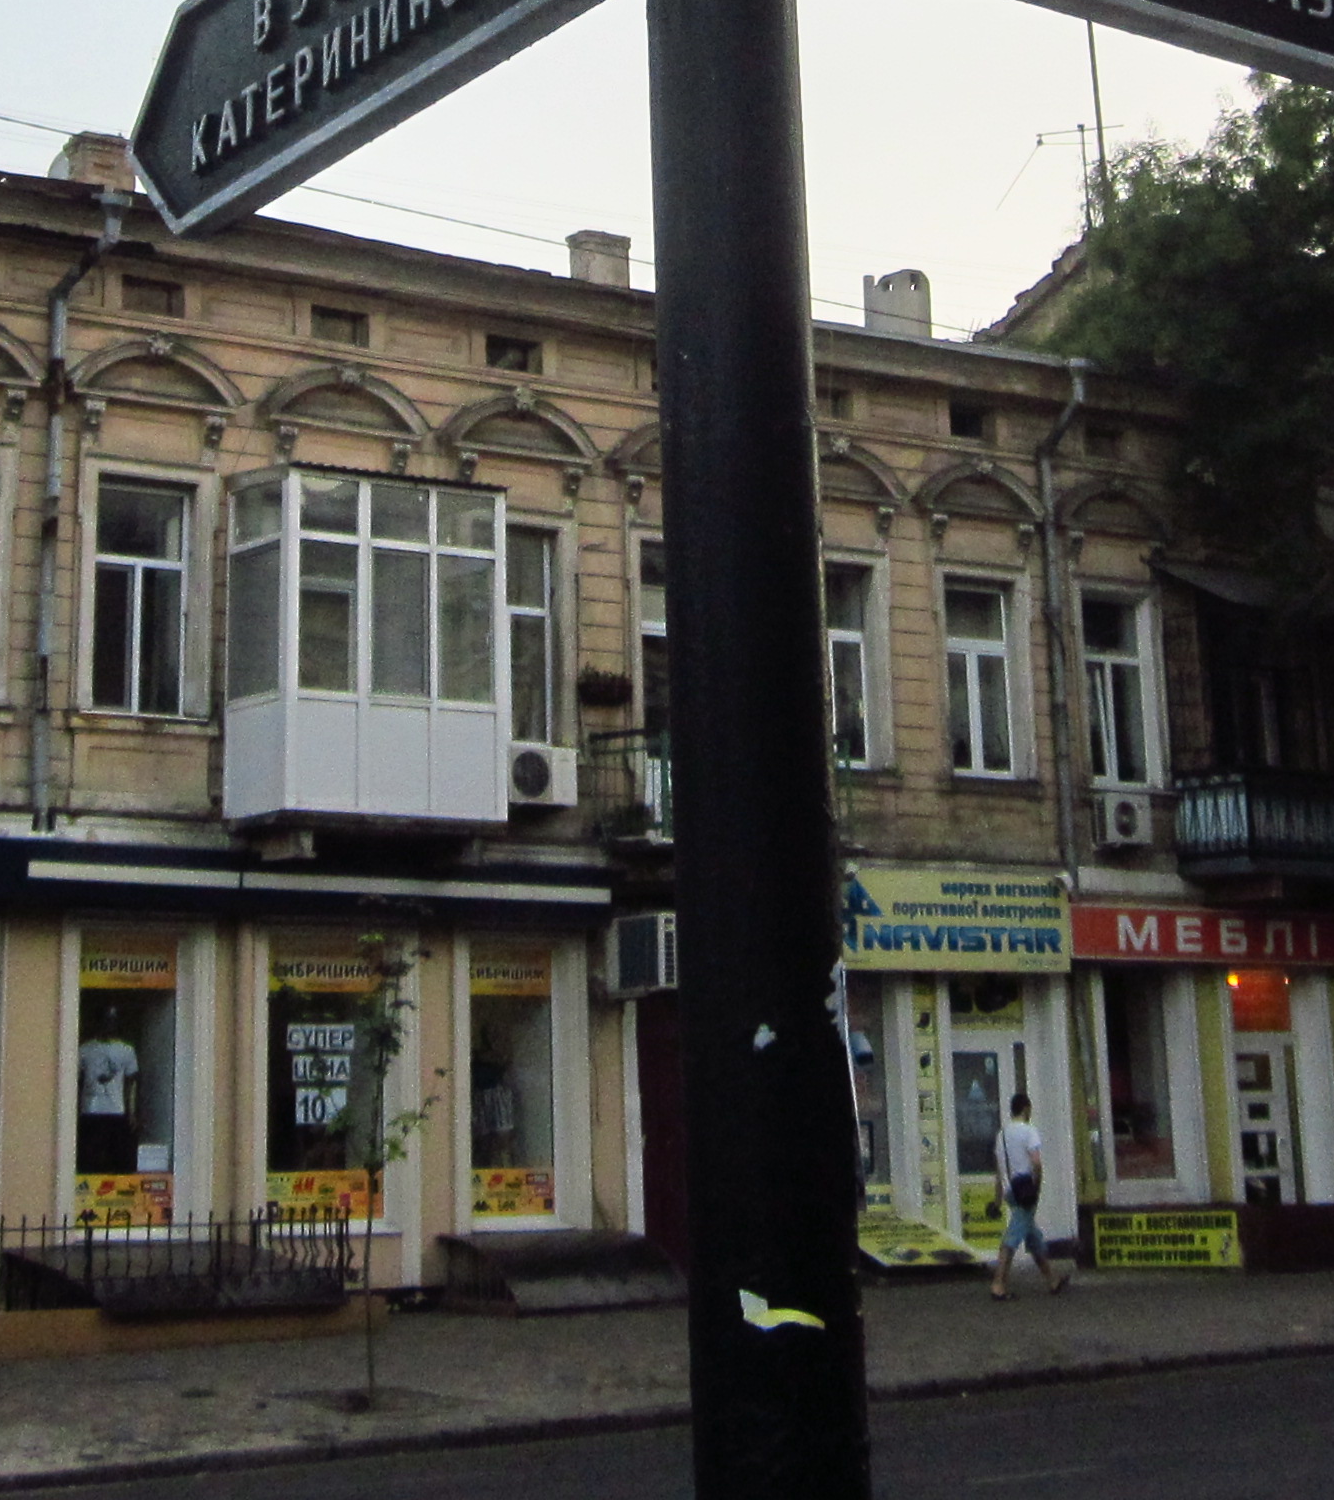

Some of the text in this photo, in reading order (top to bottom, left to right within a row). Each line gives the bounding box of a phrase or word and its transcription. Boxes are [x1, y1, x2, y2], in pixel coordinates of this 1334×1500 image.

[862, 924, 1063, 955] NAVISTAR
[1116, 914, 1319, 958] МЕБЛІ
[88, 959, 169, 974] ИБРИШИМ
[288, 1028, 354, 1048] СУПЕР
[299, 1096, 327, 1122] 10
